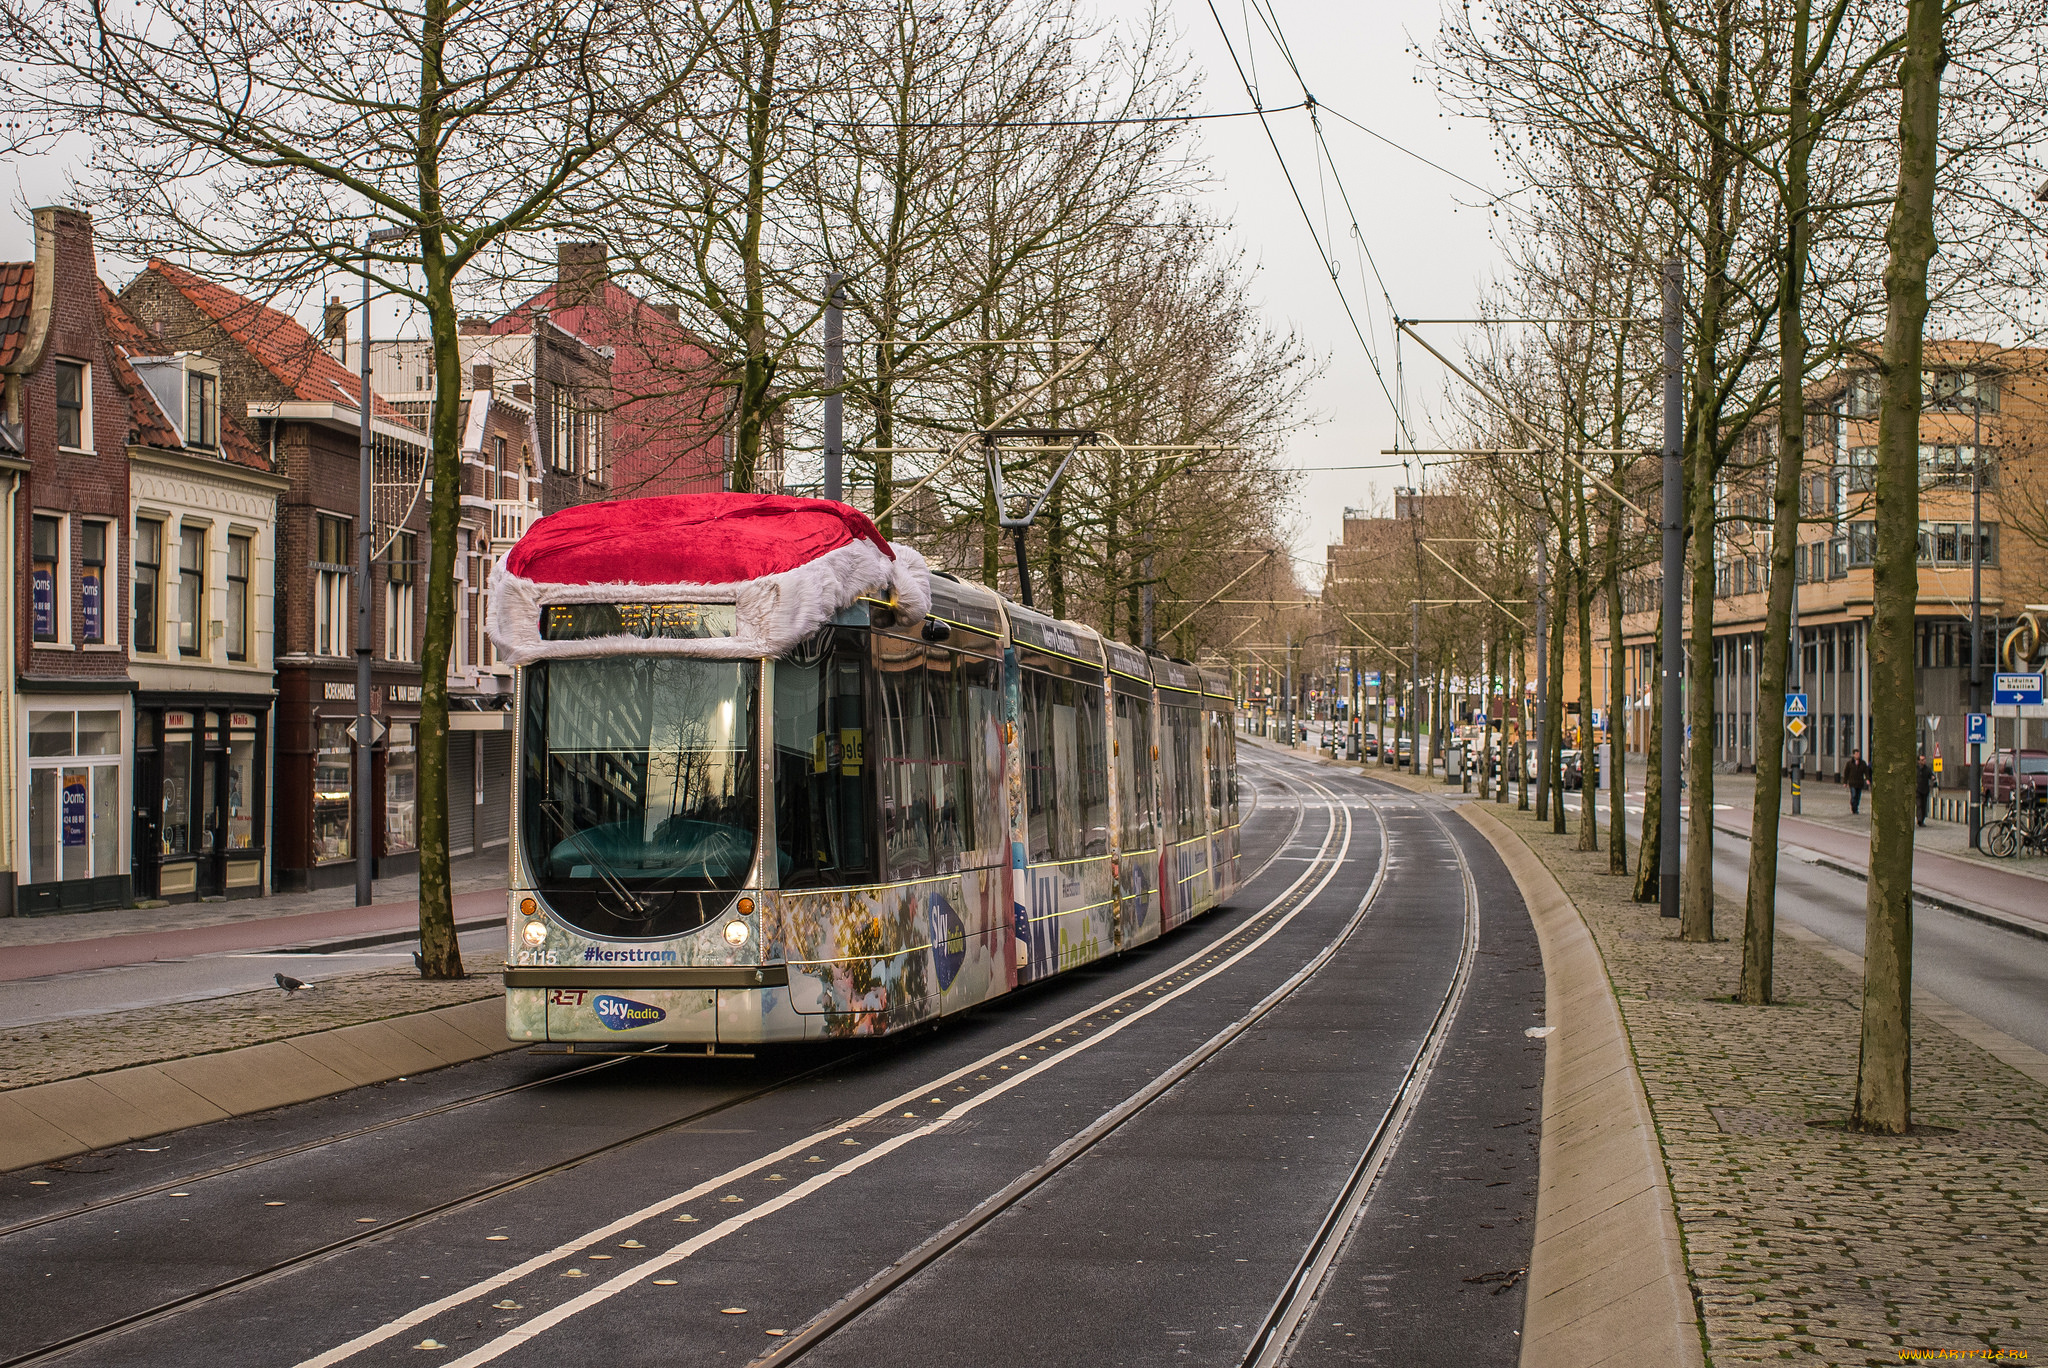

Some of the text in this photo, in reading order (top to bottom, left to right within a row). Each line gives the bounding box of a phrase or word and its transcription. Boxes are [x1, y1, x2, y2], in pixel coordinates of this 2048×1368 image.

[33, 577, 50, 590] oms
[83, 584, 98, 596] oms
[325, 682, 355, 700] BOEKHANDEL
[1971, 716, 1983, 731] P
[63, 791, 84, 804] Ooms
[519, 951, 557, 965] 2115
[584, 947, 676, 962] #kersttram
[552, 990, 588, 1005] RET
[599, 1000, 659, 1019] Sky Radio
